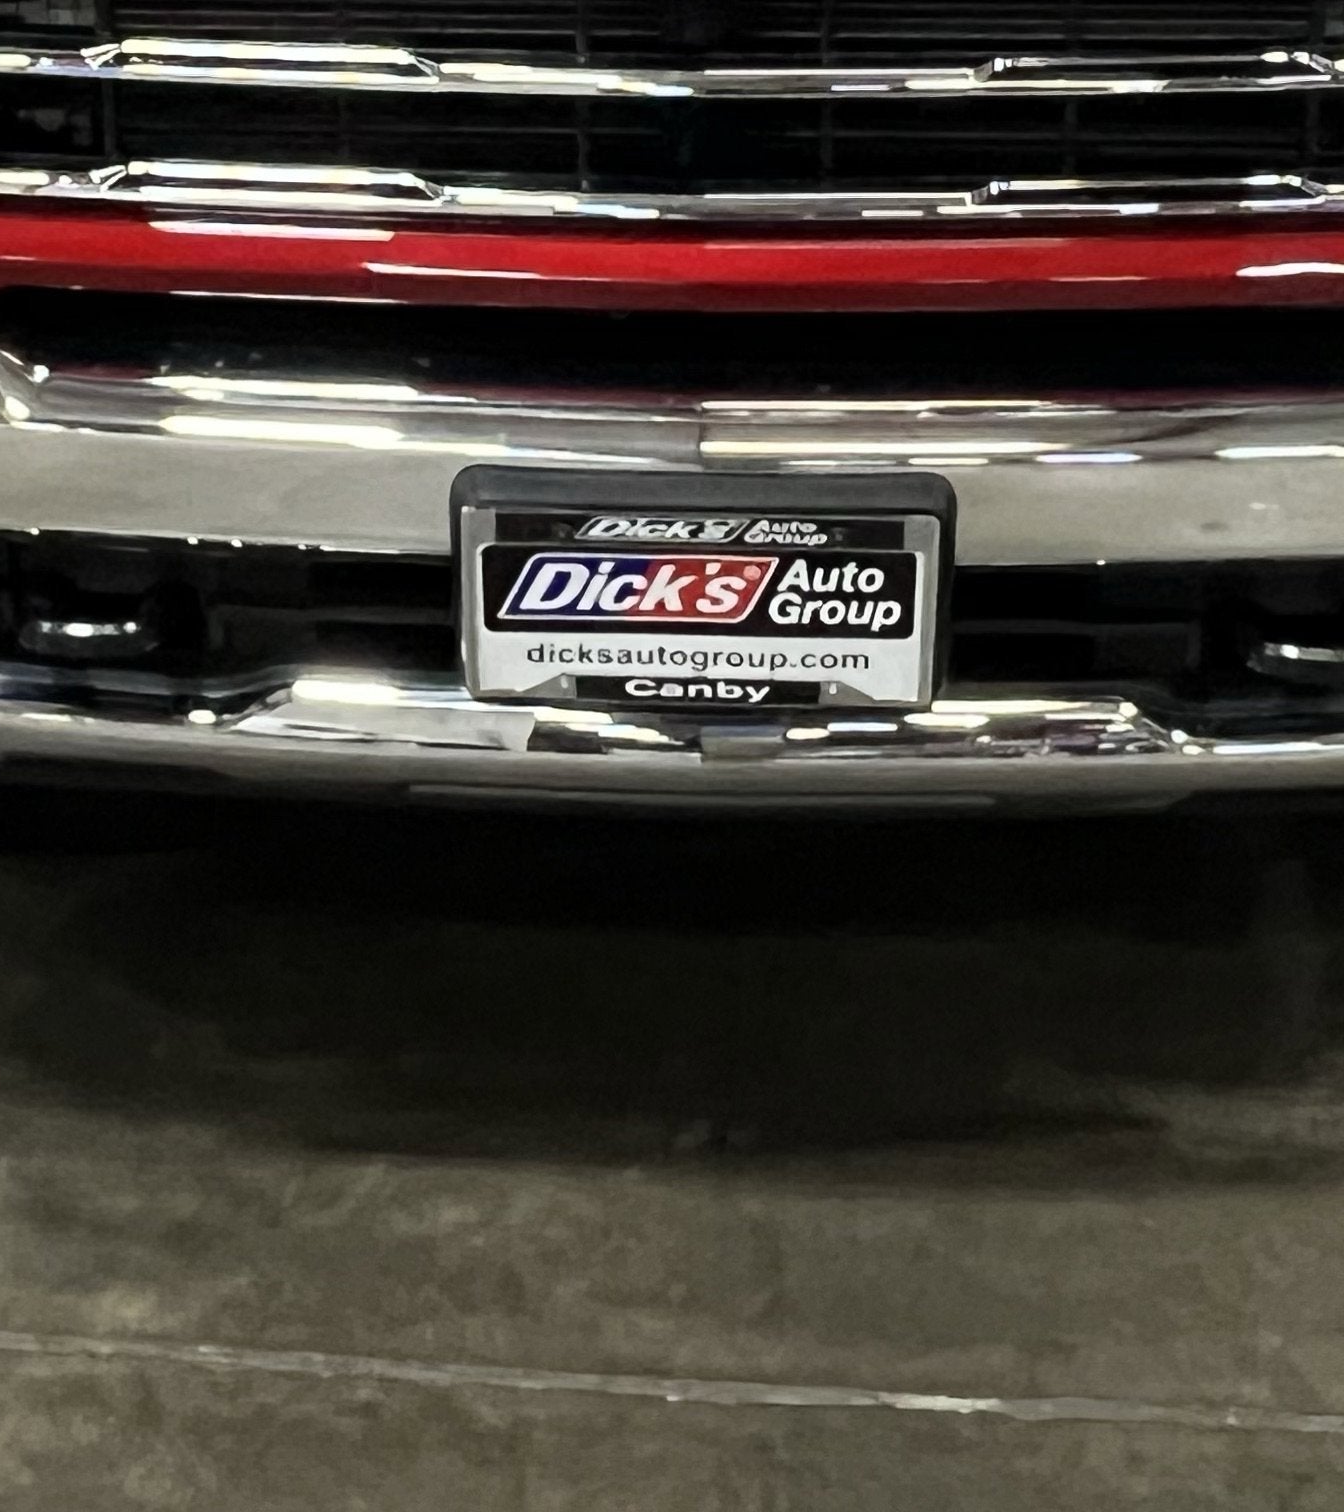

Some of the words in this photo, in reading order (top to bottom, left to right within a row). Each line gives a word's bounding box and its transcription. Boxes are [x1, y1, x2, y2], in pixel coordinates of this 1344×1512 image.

[744, 530, 829, 547] Group
[752, 519, 818, 533] Auto
[519, 559, 747, 614] Dick's
[777, 558, 885, 594] Auto
[768, 594, 903, 631] Group
[526, 643, 871, 672] dicksautogroup.com
[624, 678, 771, 704] Canby
